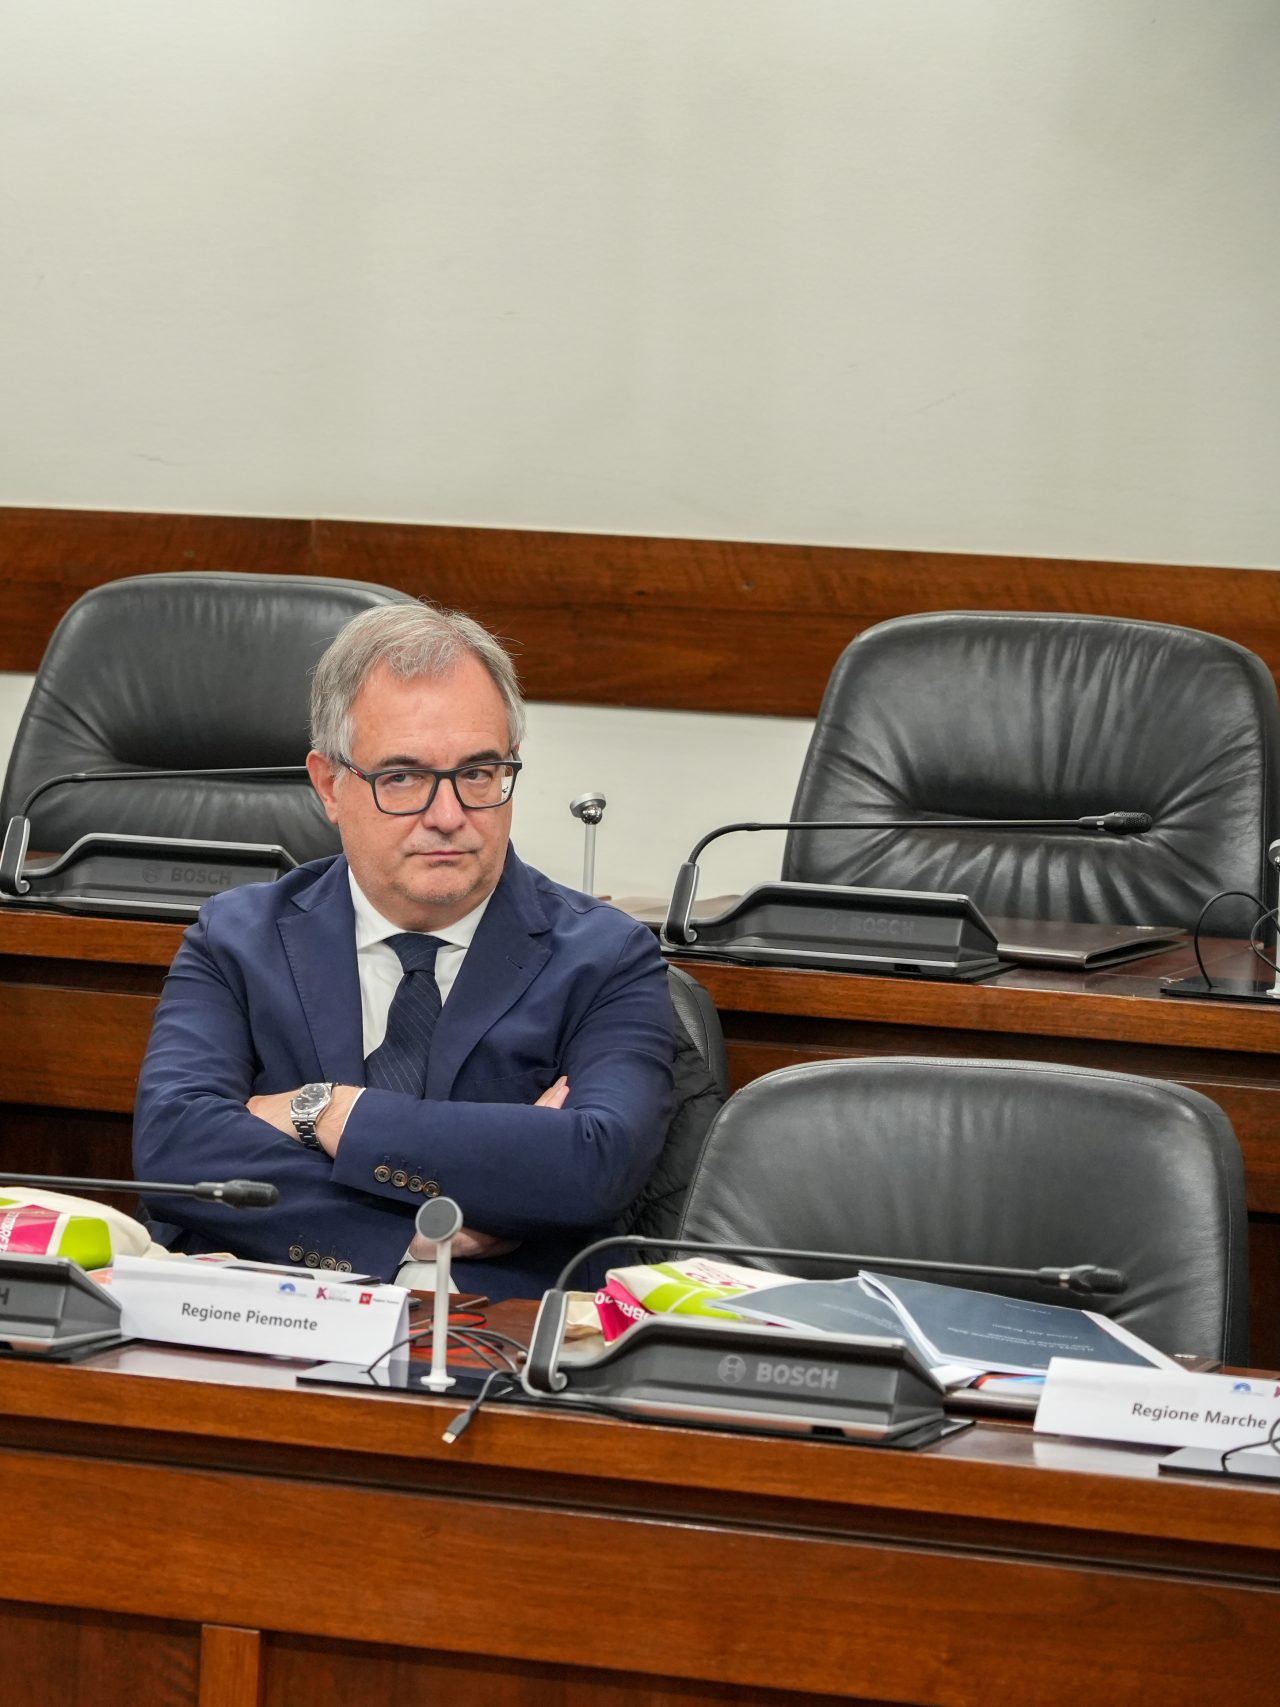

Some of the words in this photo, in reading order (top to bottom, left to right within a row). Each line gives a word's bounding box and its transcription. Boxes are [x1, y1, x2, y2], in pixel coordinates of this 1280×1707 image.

[171, 867, 232, 885] BOSCH
[850, 916, 915, 936] BOSCH
[181, 1302, 241, 1321] Regione
[246, 1310, 318, 1331] Piemonte
[756, 1362, 840, 1390] BOSCH
[1132, 1402, 1199, 1421] Regione
[1204, 1410, 1268, 1429] Marche
